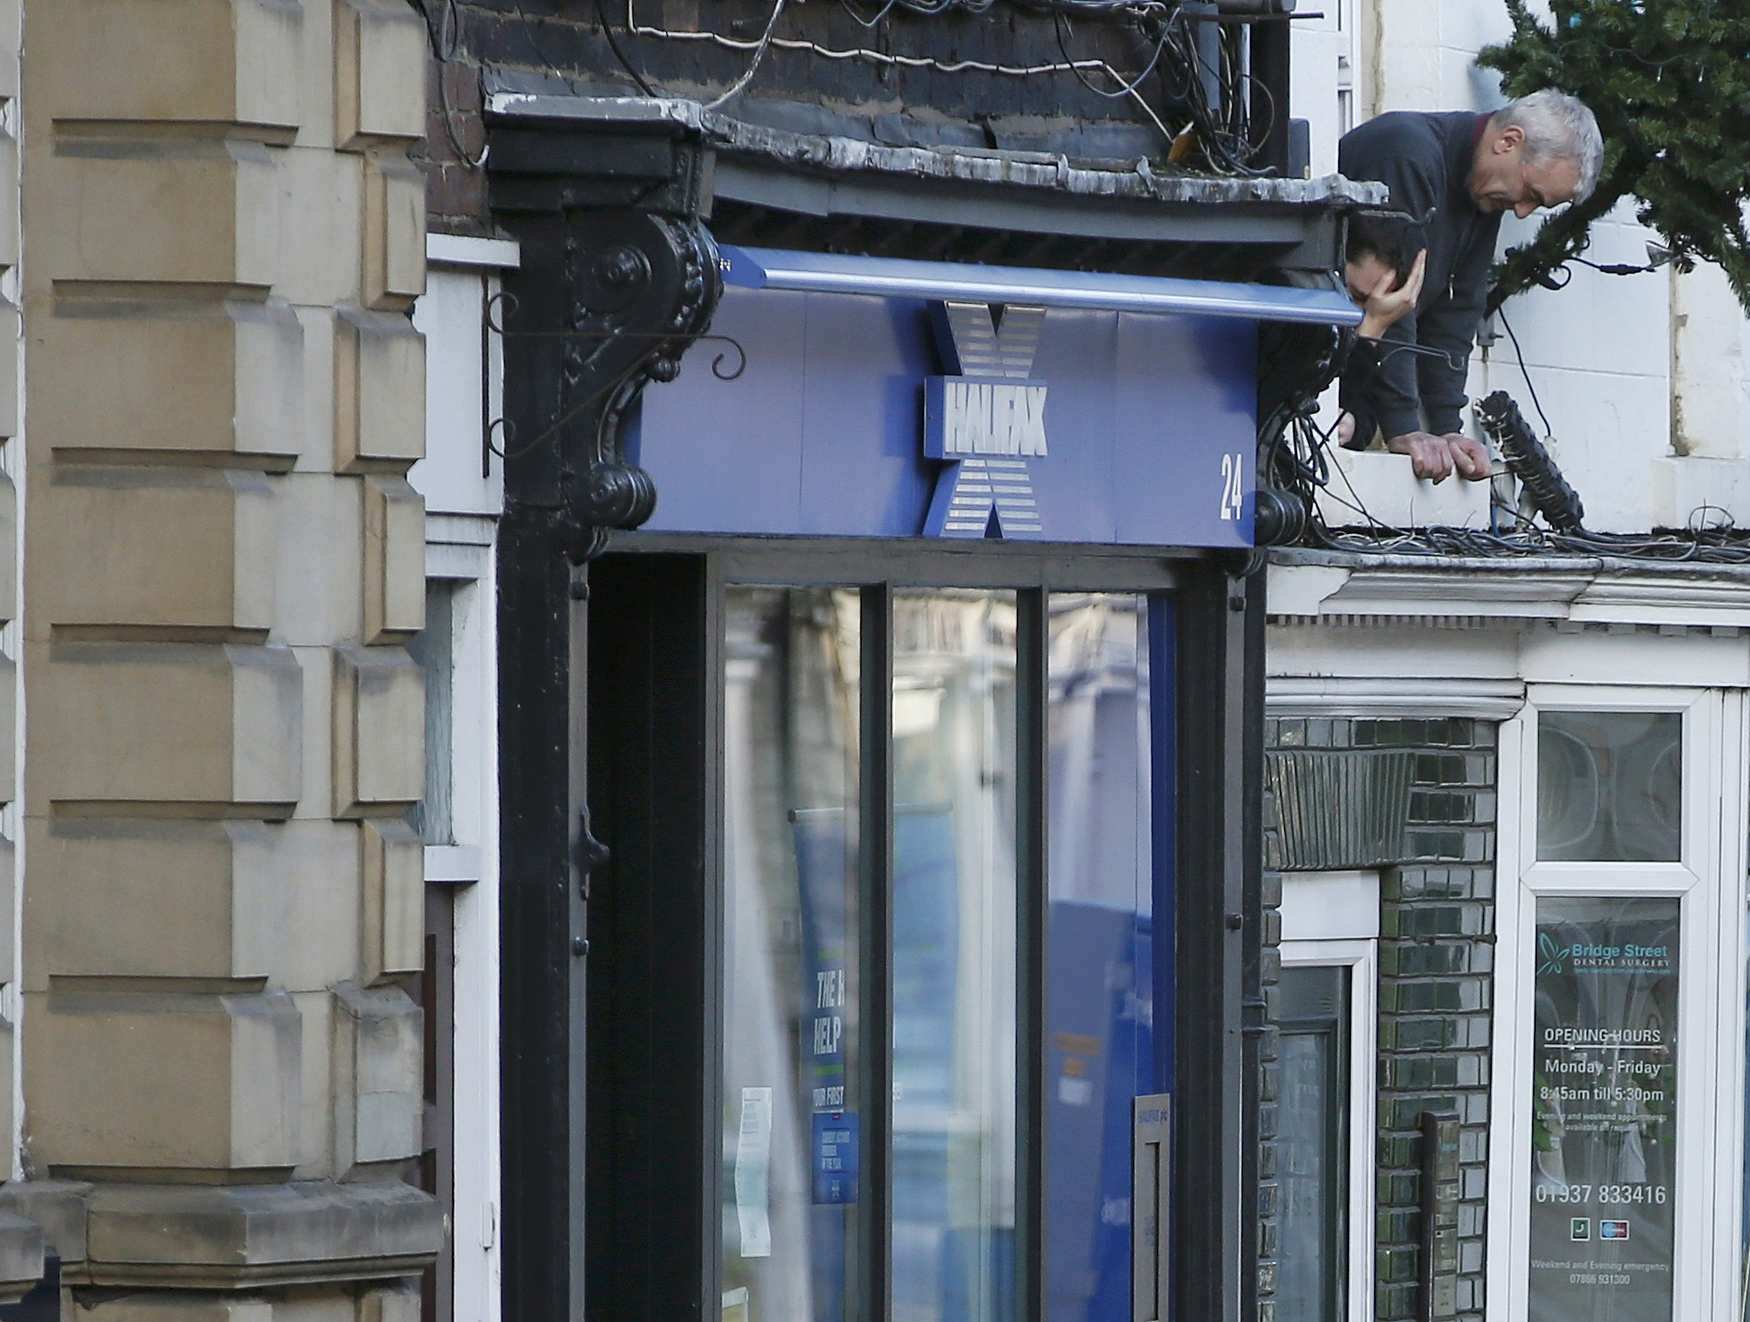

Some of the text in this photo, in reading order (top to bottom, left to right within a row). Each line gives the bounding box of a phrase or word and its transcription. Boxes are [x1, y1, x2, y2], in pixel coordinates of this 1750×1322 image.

[944, 382, 1048, 457] HALIFAX
[1220, 453, 1243, 520] 24
[1572, 943, 1668, 959] Bridge Street
[1621, 959, 1671, 967] SURGERY
[814, 1016, 841, 1055] HELP
[1544, 1028, 1661, 1042] OPENING HOURS
[1545, 1059, 1604, 1076] Monday
[1617, 1060, 1661, 1076] Friday
[1540, 1086, 1664, 1102] 8:45am till 5:30pm
[1535, 1184, 1667, 1204] 01937 833416
